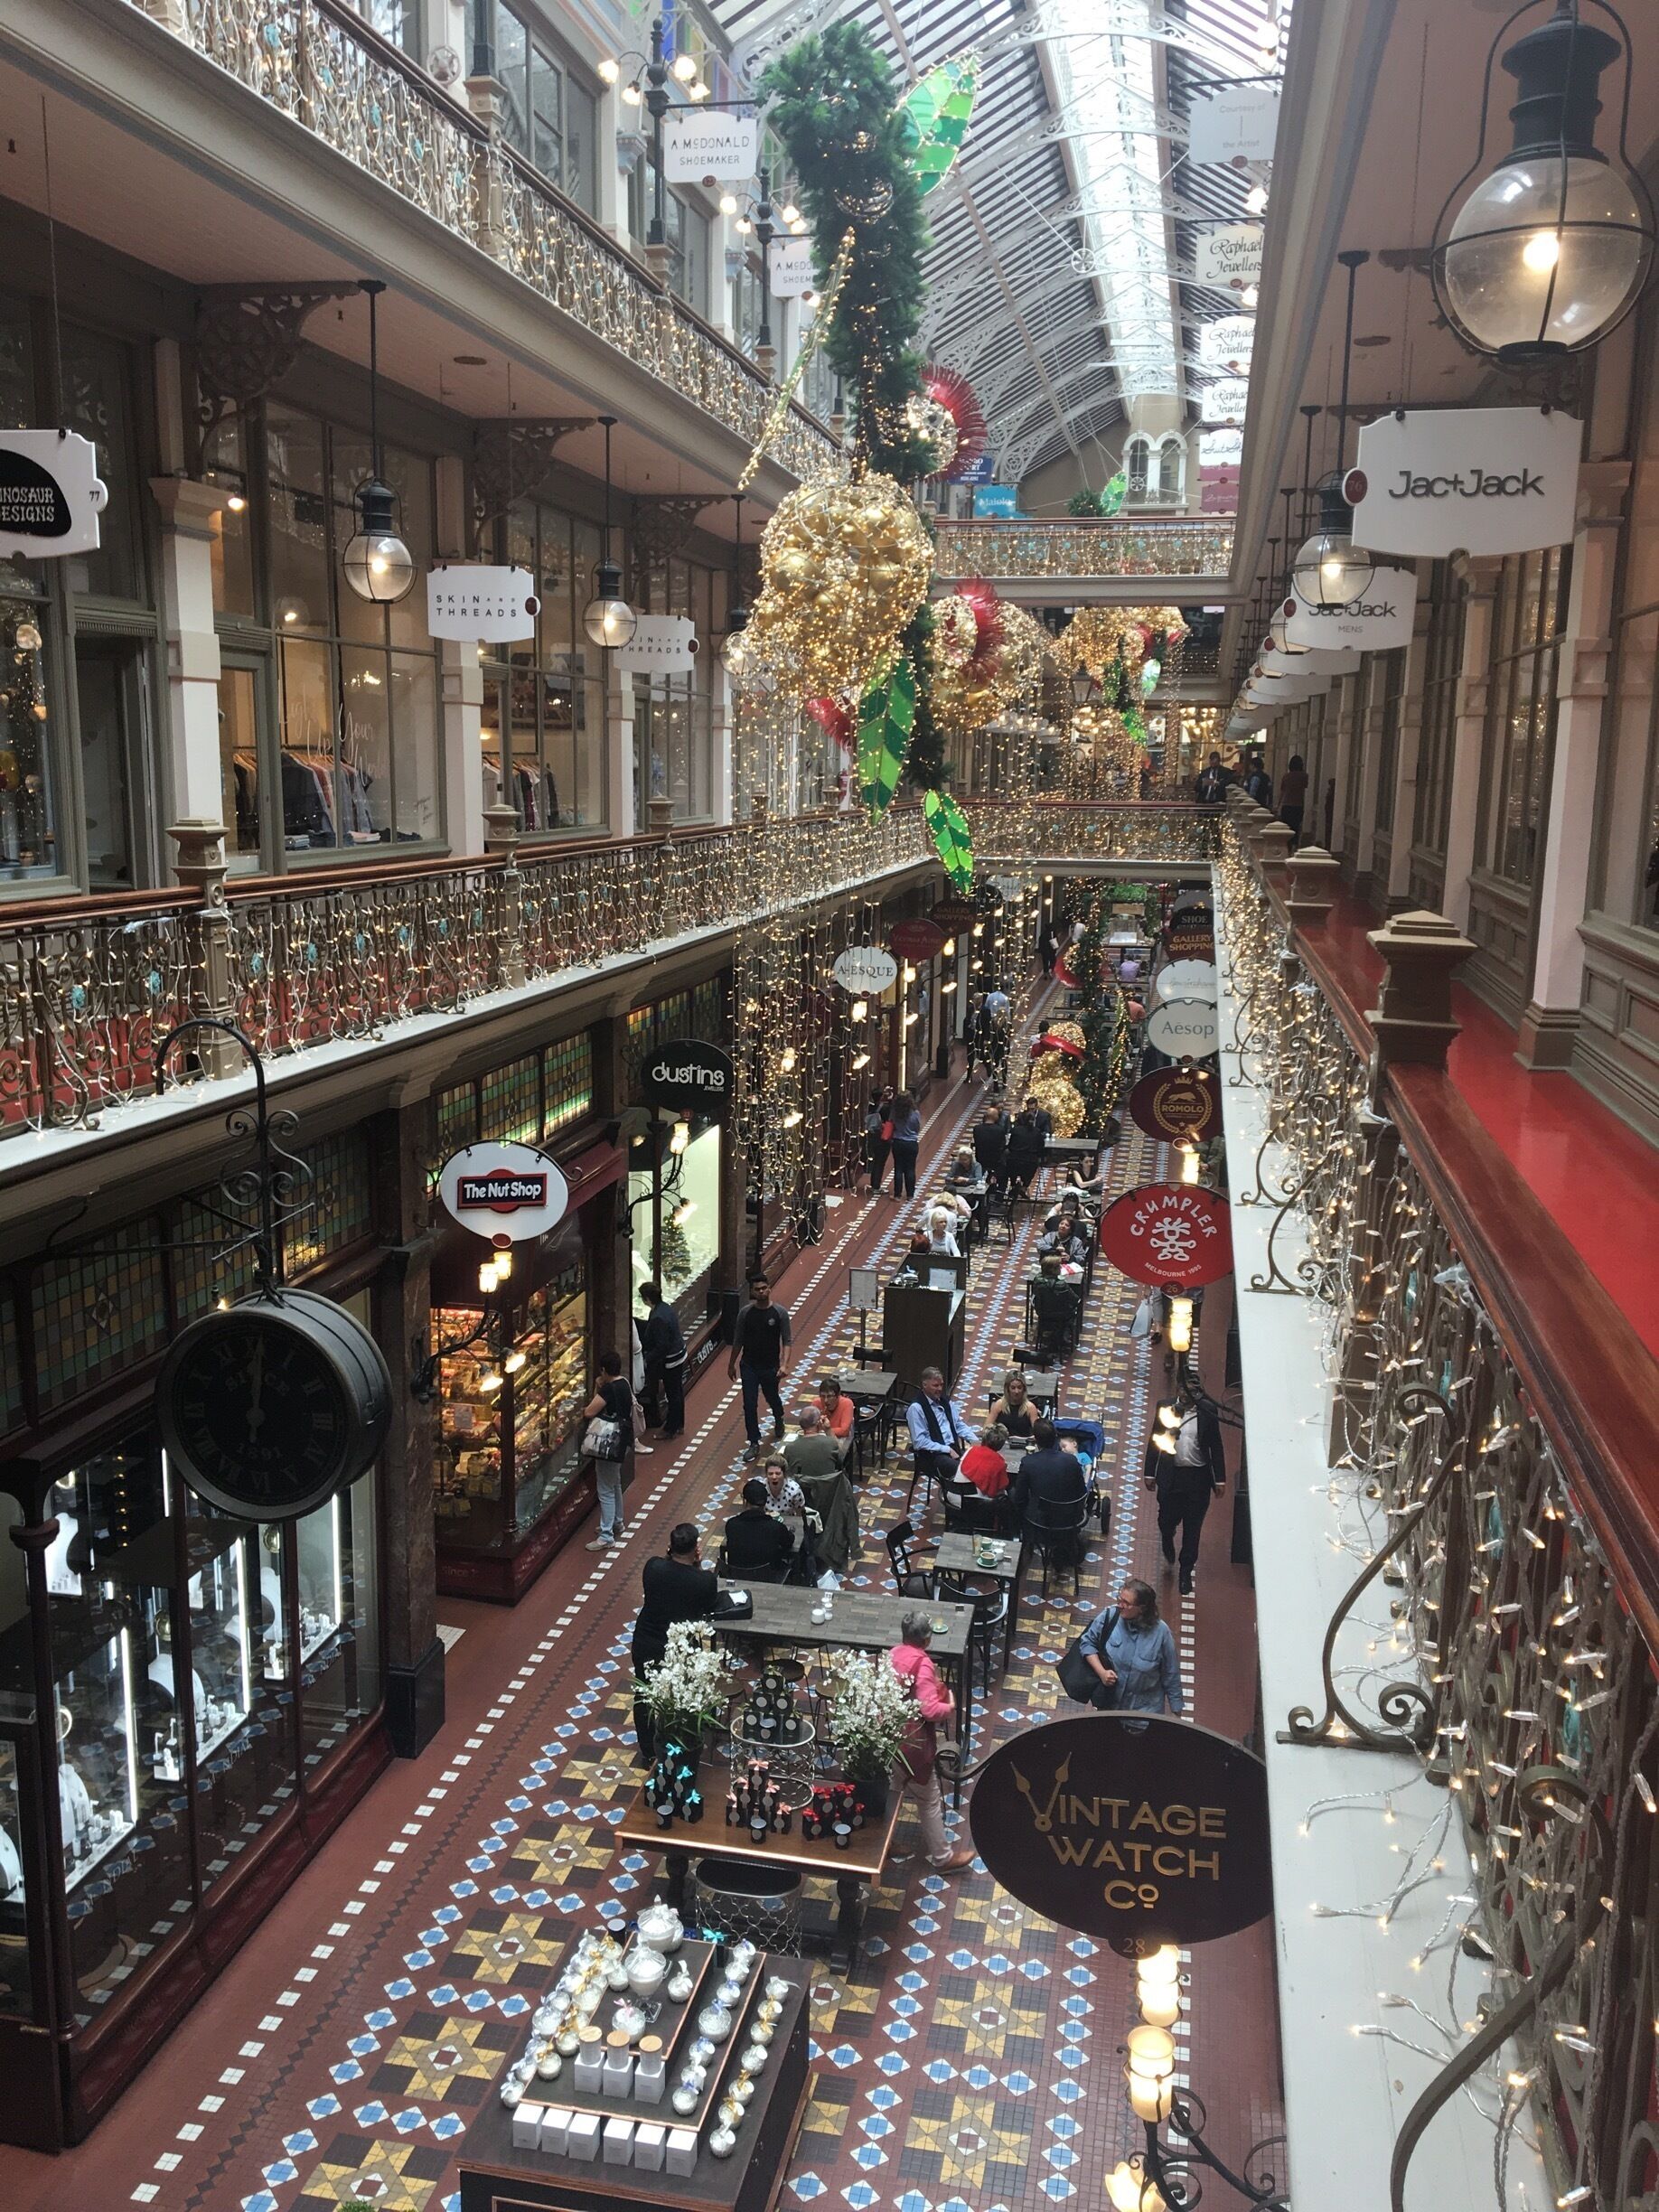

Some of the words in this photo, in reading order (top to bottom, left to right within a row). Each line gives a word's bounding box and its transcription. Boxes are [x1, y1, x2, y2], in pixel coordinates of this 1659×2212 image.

[670, 138, 679, 151] A
[680, 155, 740, 166] SHOEMAKER
[786, 260, 812, 271] McDO
[1206, 256, 1263, 278] Jewellers
[783, 275, 811, 284] SHOEM
[1348, 479, 1363, 494] 76
[1389, 468, 1545, 499] Jac+Jack
[0, 486, 54, 503] INOSAUR
[89, 491, 100, 501] 77
[2, 506, 54, 522] ESIGNS
[436, 595, 480, 604] SKIN
[436, 608, 517, 618] THREADS
[1338, 625, 1364, 633] MENS
[1181, 914, 1208, 923] SHOE
[1173, 933, 1213, 943] GALLERY
[837, 965, 894, 977] A-ESQUE
[651, 1061, 725, 1086] dustins
[1162, 1104, 1204, 1113] ROMOLO
[464, 1183, 486, 1199] The
[488, 1182, 510, 1198] Nut
[511, 1181, 541, 1199] Shop
[1130, 1195, 1217, 1238] CRUMPLER
[1144, 1261, 1186, 1278] MELBOURNE
[1167, 1285, 1178, 1293] 26
[1010, 1751, 1227, 1839] VINTAGE
[1047, 1835, 1220, 1880] WATCH
[1122, 1938, 1146, 1954] 28
